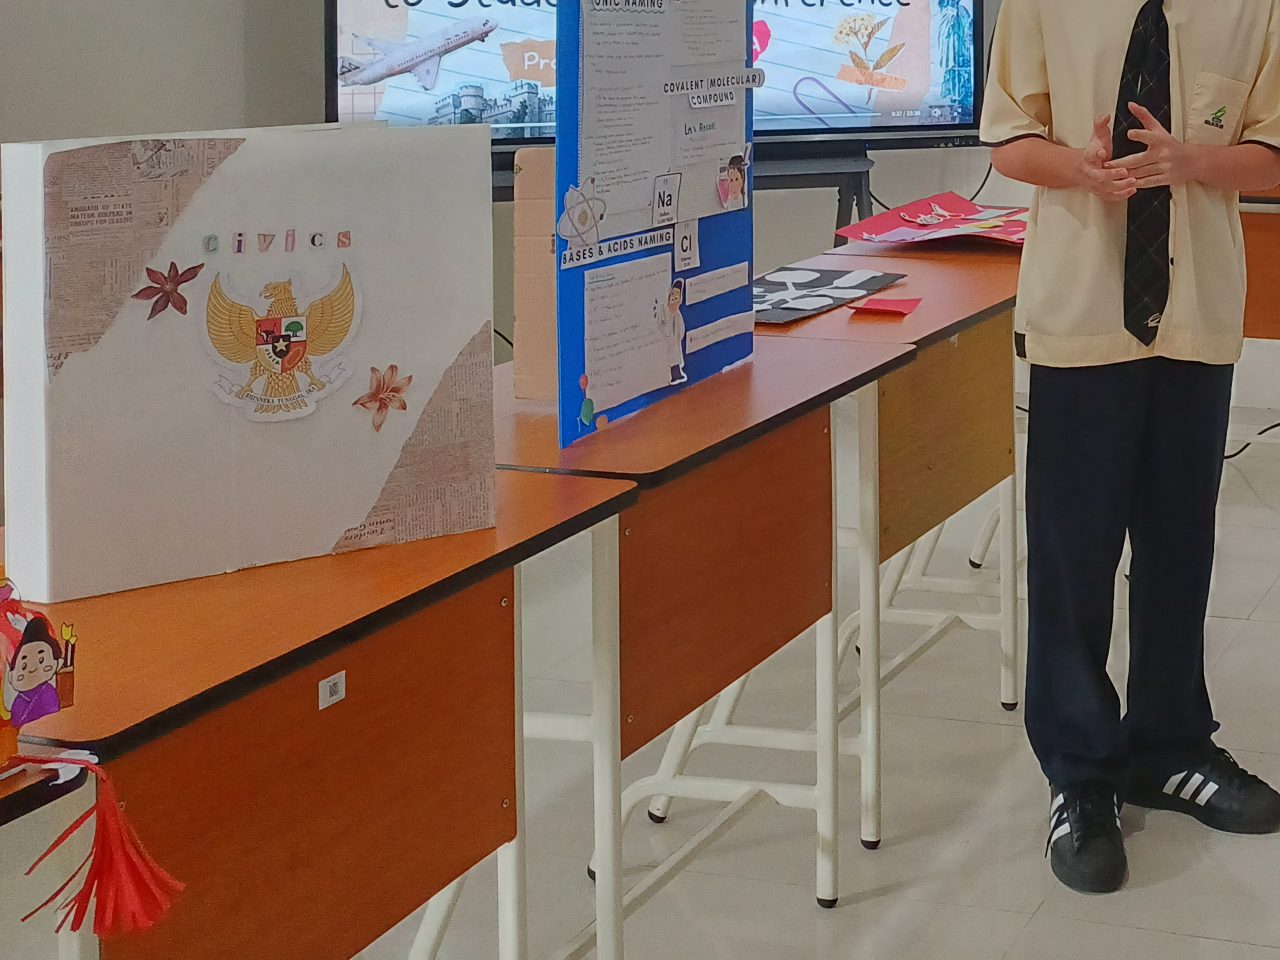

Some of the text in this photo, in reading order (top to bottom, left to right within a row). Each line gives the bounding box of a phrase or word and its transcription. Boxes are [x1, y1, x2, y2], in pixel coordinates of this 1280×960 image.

[663, 73, 763, 93] COVALENT (MOLECULAR)
[690, 91, 734, 106] COMPOUND
[657, 190, 672, 208] Na
[562, 231, 671, 265] BASES & ACIDS NAMING
